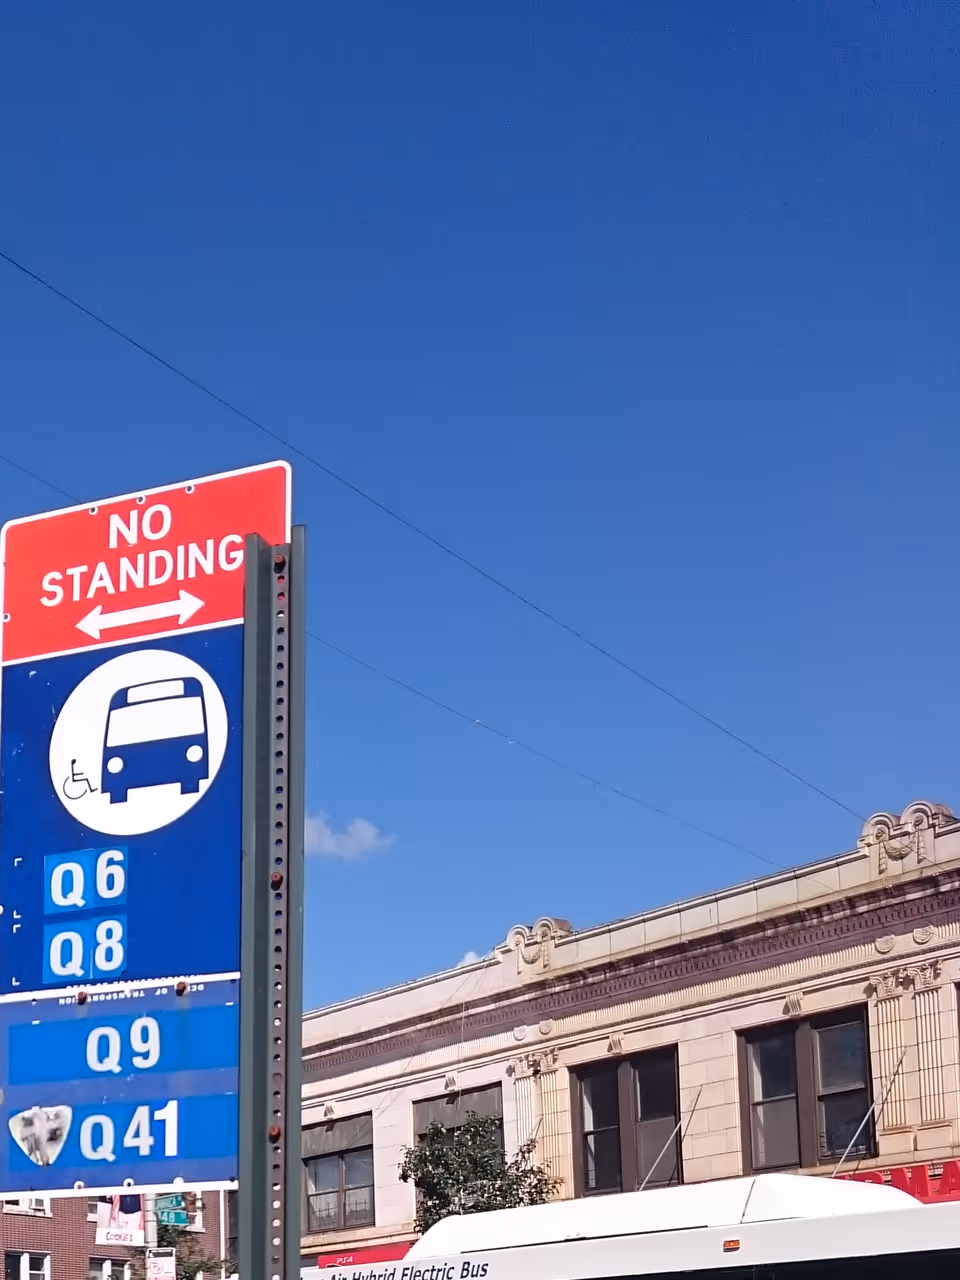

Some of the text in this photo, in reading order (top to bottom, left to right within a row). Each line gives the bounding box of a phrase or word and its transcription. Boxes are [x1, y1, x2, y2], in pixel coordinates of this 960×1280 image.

[108, 504, 172, 549] NO
[40, 534, 244, 607] STANDING
[460, 1261, 489, 1279] Bus
